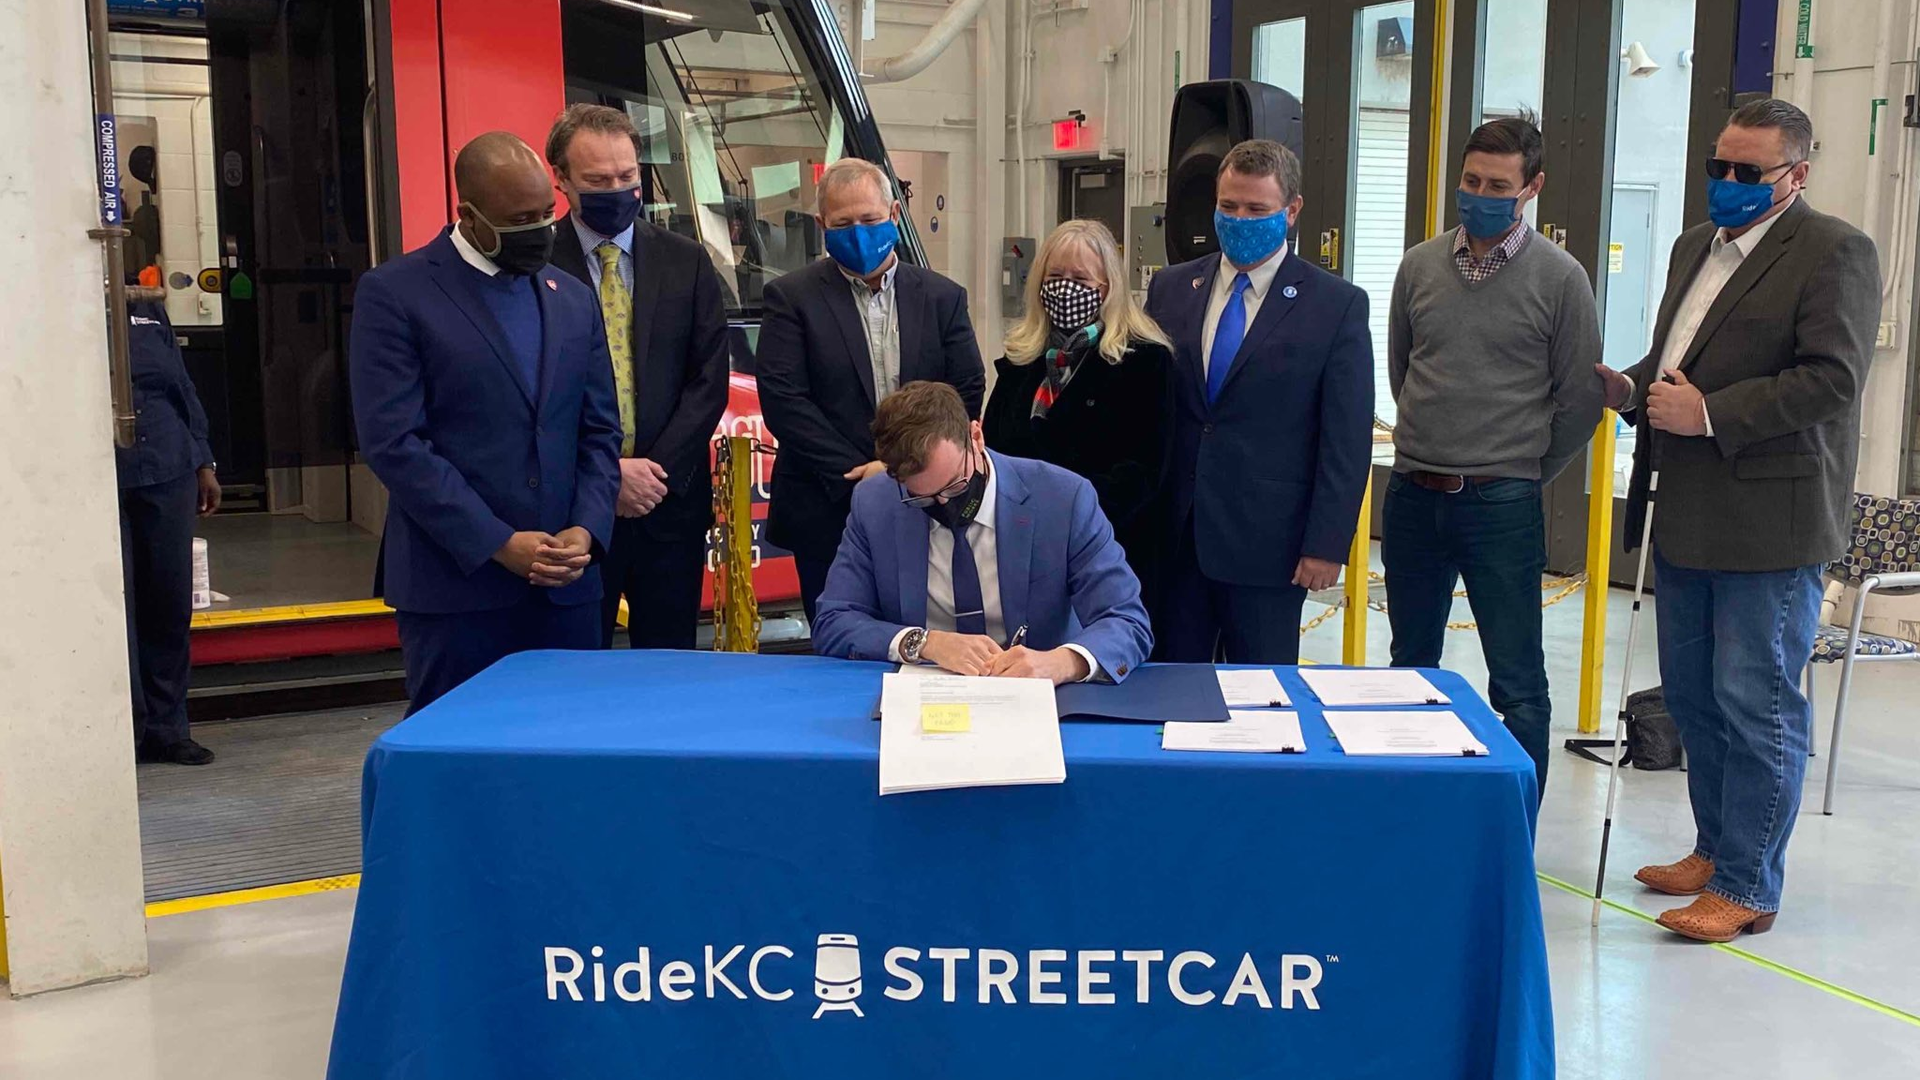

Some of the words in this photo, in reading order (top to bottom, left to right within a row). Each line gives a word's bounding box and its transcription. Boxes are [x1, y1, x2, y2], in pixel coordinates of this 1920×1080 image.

[101, 120, 116, 188] COMPRESSED
[104, 191, 116, 209] AIR
[544, 945, 794, 1001] RideKC
[884, 946, 1323, 1010] STREETCAR
